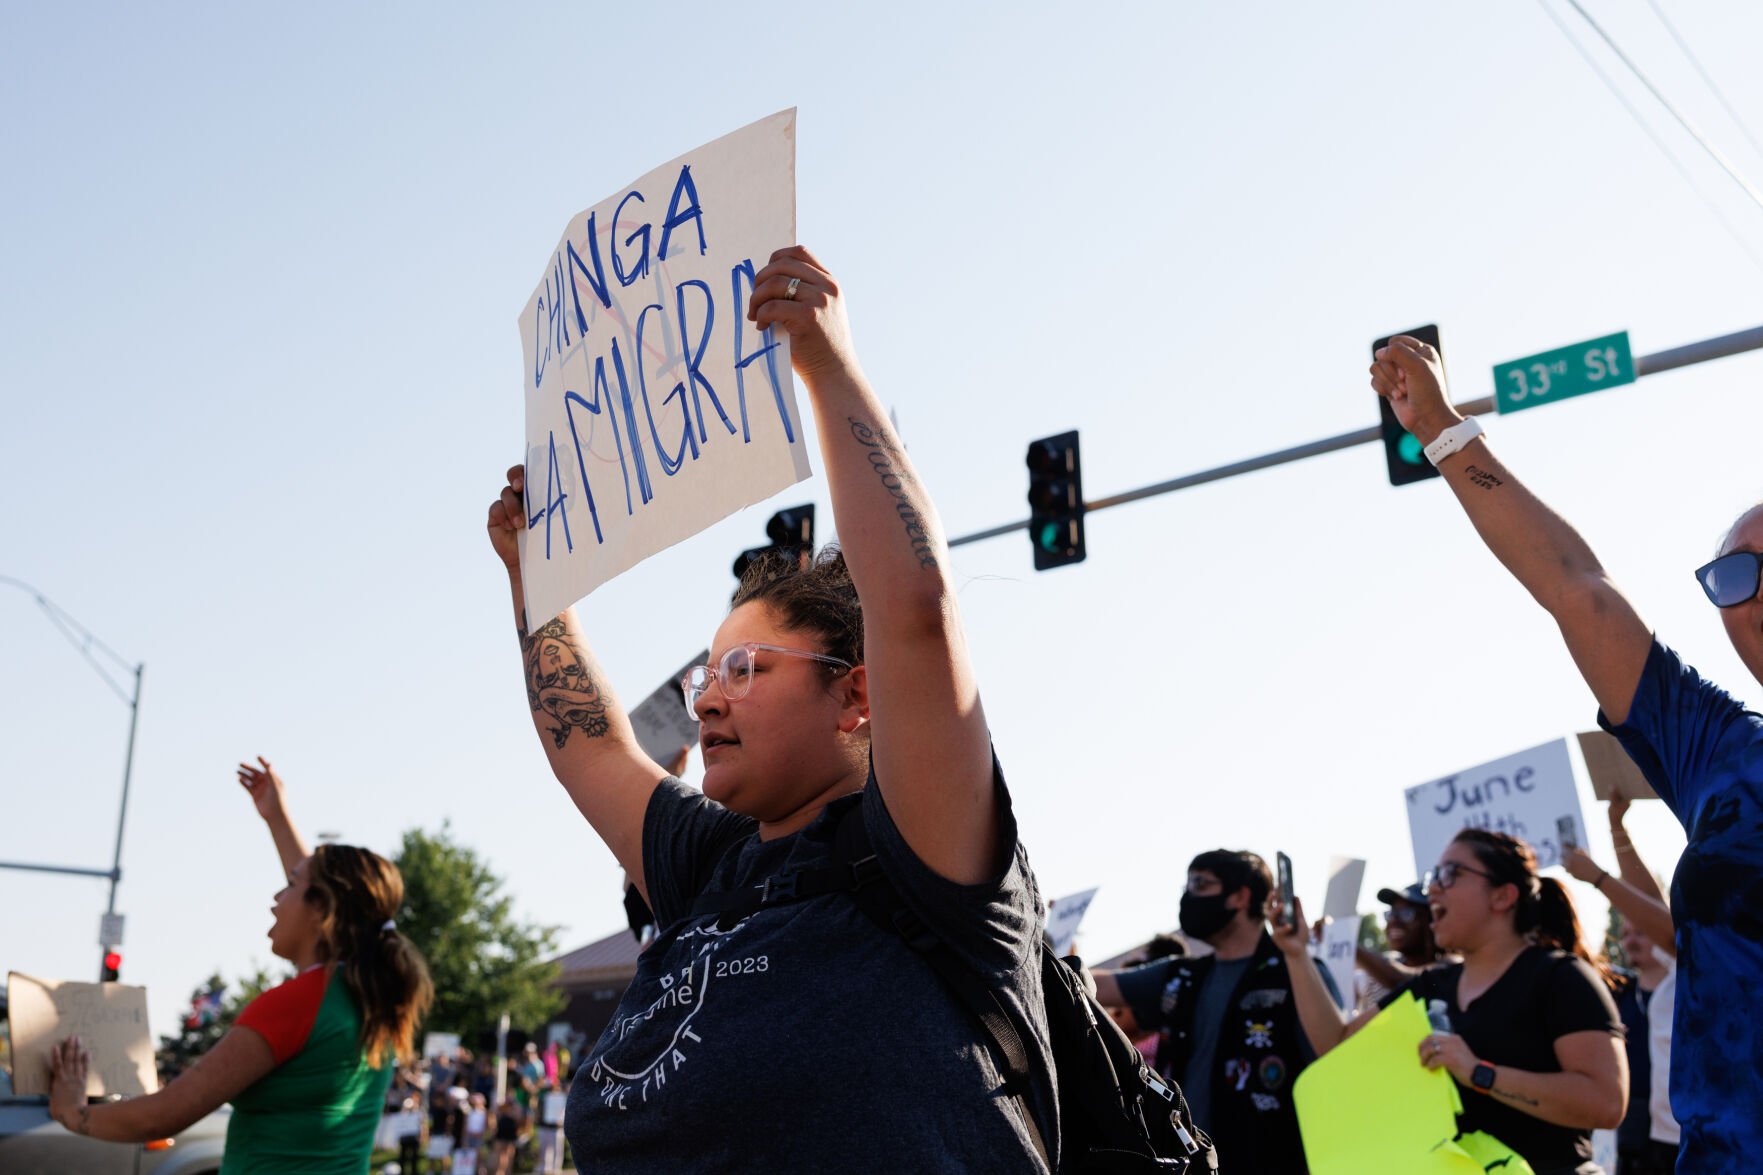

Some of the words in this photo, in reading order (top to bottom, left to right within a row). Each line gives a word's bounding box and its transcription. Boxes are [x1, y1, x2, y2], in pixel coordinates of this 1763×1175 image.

[535, 164, 706, 388] CHINGA
[1583, 346, 1620, 382] St
[527, 430, 573, 560] LA
[565, 258, 795, 545] MIGRA
[1434, 765, 1536, 815] June
[715, 955, 769, 977] 2023
[642, 1024, 702, 1102] THAT
